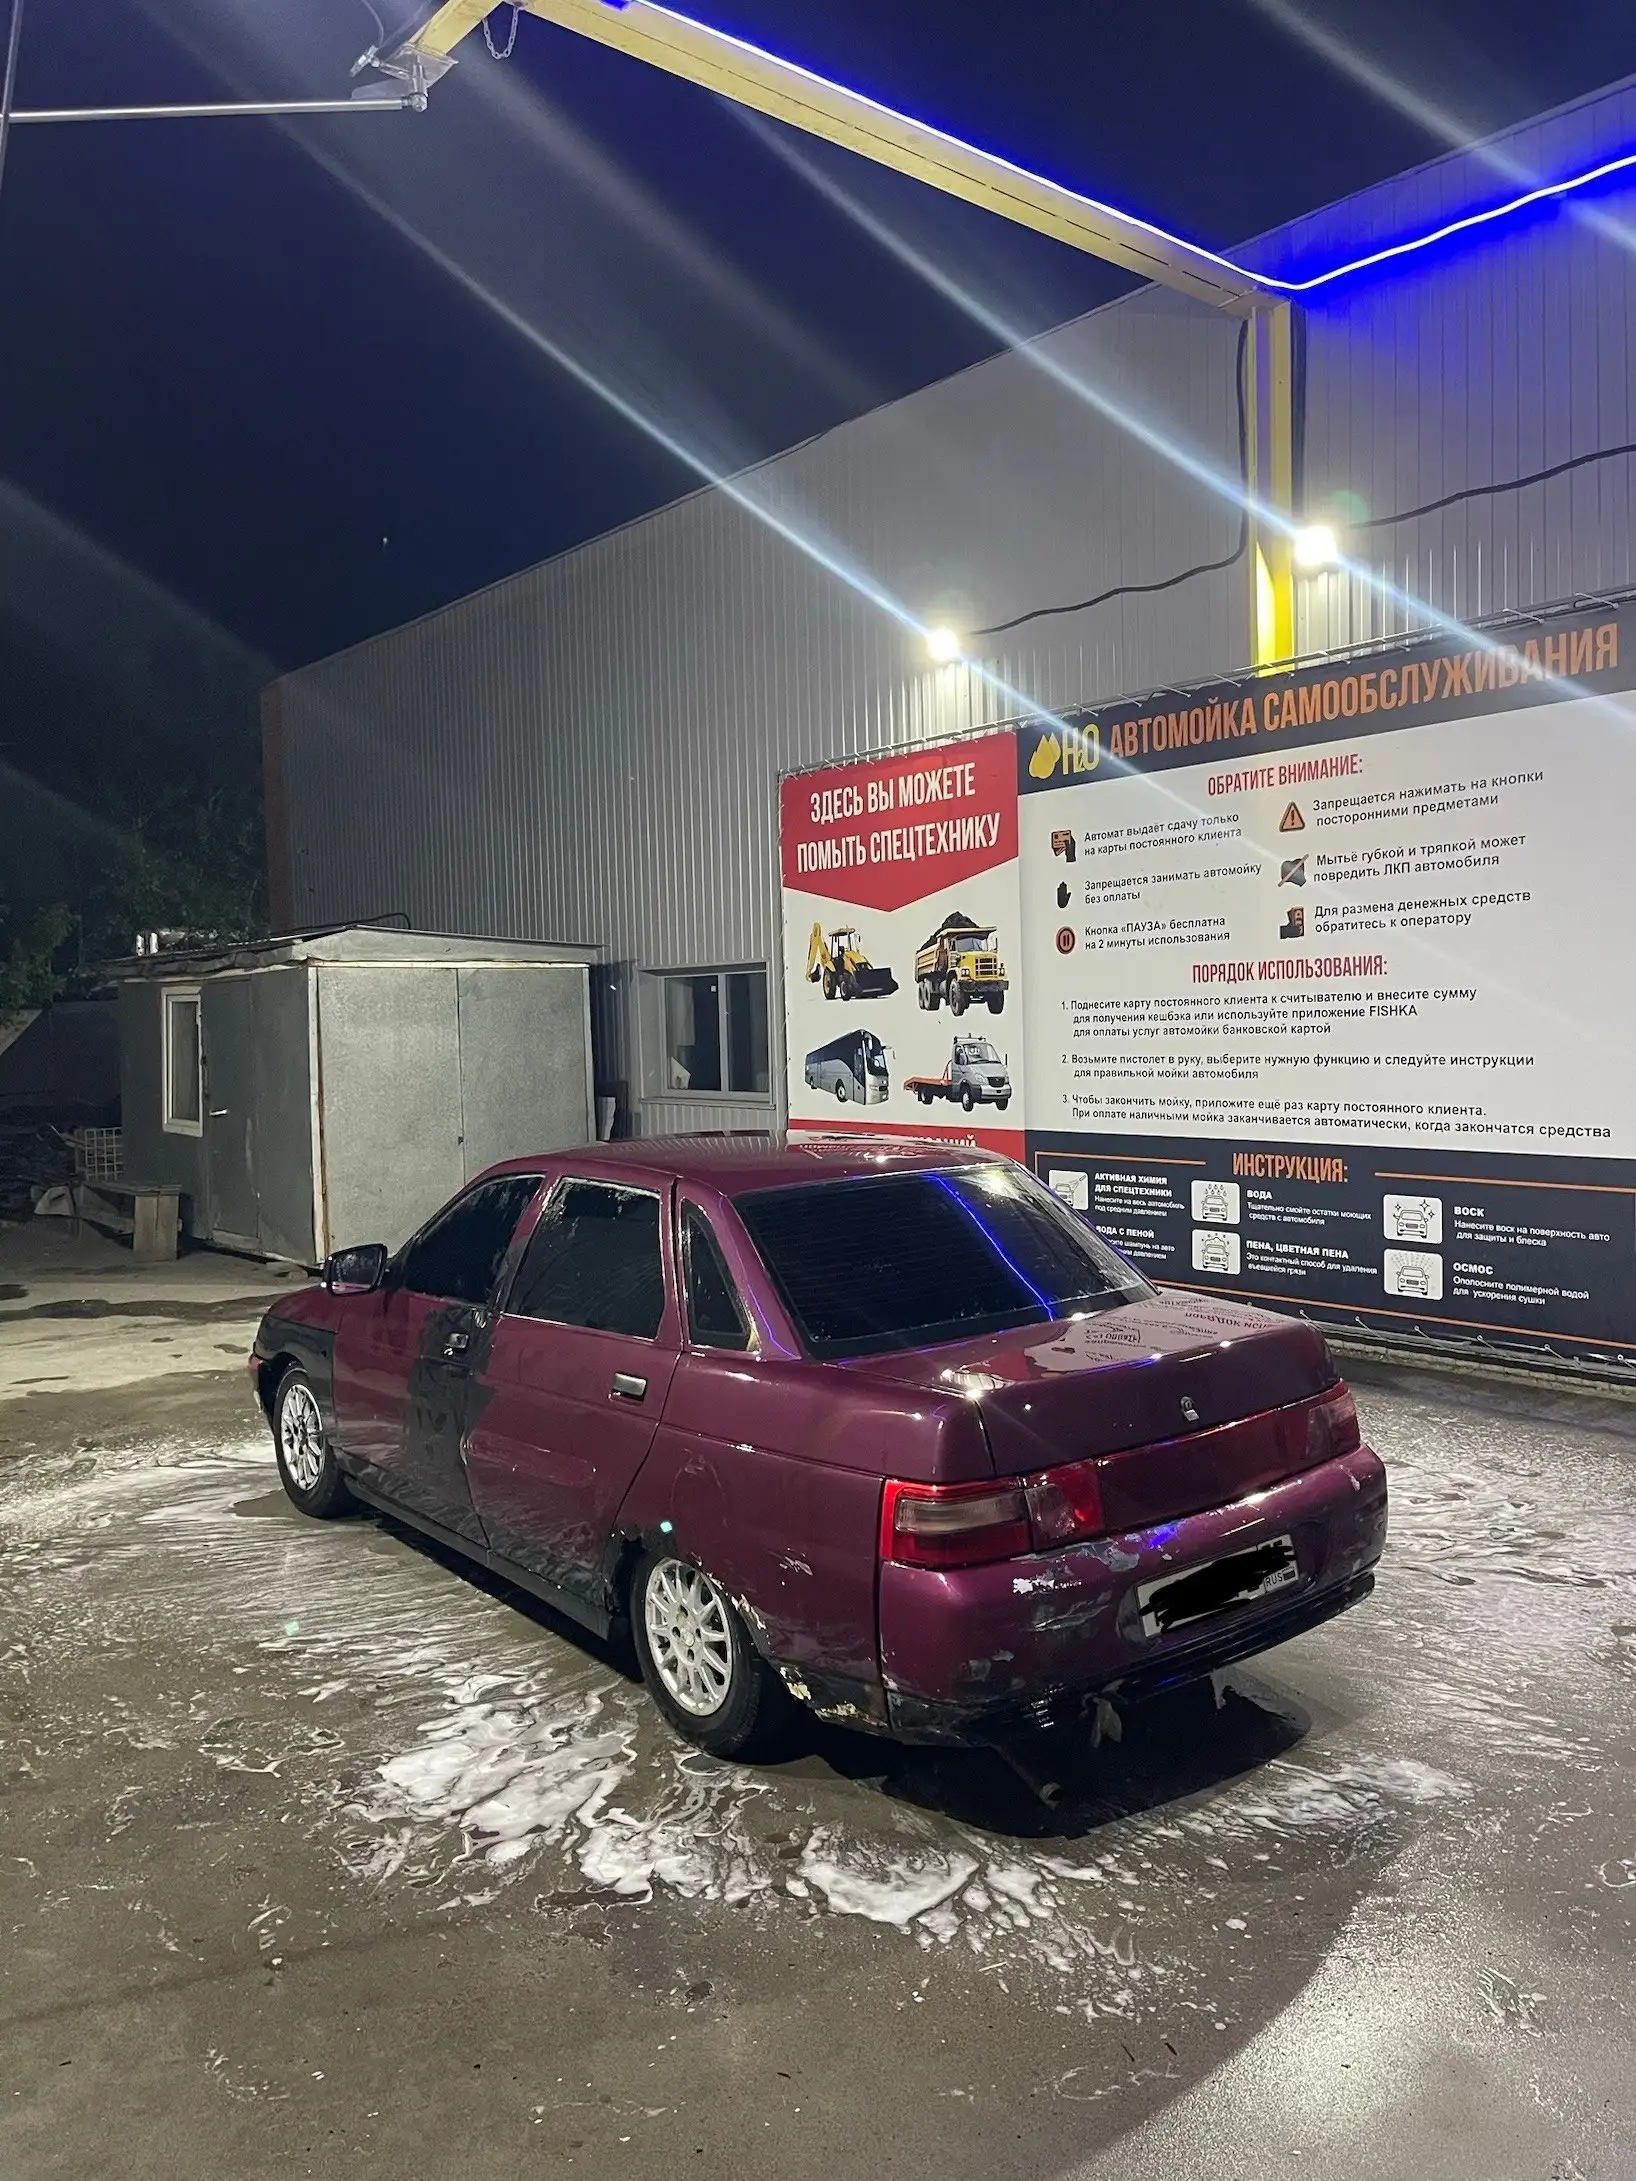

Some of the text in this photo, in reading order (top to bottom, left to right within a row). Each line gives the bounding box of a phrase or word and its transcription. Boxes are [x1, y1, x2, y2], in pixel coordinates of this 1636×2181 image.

[1110, 623, 1618, 759] АВТОМОЙКА САМООБСЛУЖИВАНИЯ
[1062, 724, 1100, 775] H2O
[1208, 754, 1363, 796] ОБРАТИТЕ ВНИМАНИЕ:
[811, 762, 976, 824] ЗДЕСЬ ВЫ МОЖЕТЕ
[1313, 771, 1543, 812] Запрещается нажимать на кнопки
[1317, 794, 1498, 826] посторонними предметами
[1085, 814, 1238, 842] Автомат выдаёт сдачу только
[797, 813, 1000, 873] ПОМЫТЬ СПЕЦТЕХНИКУ
[1085, 828, 1242, 856] на карты постоянного клиента
[1317, 835, 1526, 866] Мытьё губкой и тряпкой может
[1085, 863, 1262, 890] Запрещается занимать автомойку
[1314, 854, 1499, 882] повредить ЛКП автомобиля
[1085, 892, 1140, 904] без оплаты
[1315, 891, 1531, 919] Для размена денежных средств
[1085, 917, 1225, 936] Кнопка «ПАУЗА» бесплатна
[1315, 912, 1471, 933] обратитесь к оператору
[1086, 932, 1230, 950] на 2 минуты использования
[1193, 955, 1388, 984] ПОРЯДОК ИСПОЛЬЗОВАНИЯ:
[1062, 988, 1477, 1011] 1. Поднесите карту постоянного клиента к считывателю и внесите сумму
[1073, 1014, 1090, 1024] для
[1093, 1013, 1145, 1025] получения
[1195, 1010, 1214, 1021] или
[1218, 1008, 1288, 1022] используйте
[1292, 1007, 1365, 1020] приложение
[1369, 1005, 1417, 1017] FISHKA
[1073, 1022, 1331, 1038] для оплаты услуг автомойки банковской картой
[1062, 1053, 1534, 1067] 2. Возьмите пистолет в руку, выберите нужную функцию и следуйте инструкции
[1074, 1067, 1258, 1079] для правильной мойки автомобиля
[1072, 1095, 1102, 1105] Чтобы
[1105, 1096, 1155, 1106] закончить
[1159, 1097, 1192, 1108] мойку,
[1196, 1098, 1254, 1109] приложите
[1258, 1098, 1281, 1109] ещё
[1284, 1101, 1304, 1111] раз
[1307, 1101, 1339, 1113] карту
[1344, 1102, 1423, 1114] постоянного
[1428, 1105, 1486, 1116] клиента.
[1072, 1108, 1610, 1138] При оплате наличными мойка заканчивается автоматически, когда закончатся средства
[1233, 1153, 1348, 1183] ИНСТРУКЦИЯ:
[1095, 1173, 1167, 1185] АКТИВНАЯ ХИМИЯ
[1113, 1186, 1172, 1197] СПЕЦТЕХНИКИ
[1247, 1190, 1272, 1200] ВОДА
[1248, 1202, 1371, 1220] Тщательно смойте остатки моющих
[1283, 1215, 1325, 1225] автомобиля
[1454, 1206, 1484, 1217] ВОСК
[1127, 1229, 1154, 1238] ПЕНОЙ
[1454, 1220, 1494, 1232] Нанесите
[1530, 1228, 1586, 1239] поверхность
[1589, 1233, 1610, 1241] авто
[1474, 1233, 1506, 1243] защиты
[1516, 1236, 1547, 1246] блеска
[1246, 1240, 1348, 1259] ПЕНА, ЦВЕТНАЯ ПЕНА
[1246, 1253, 1259, 1261] Это
[1301, 1258, 1325, 1268] способ
[1327, 1262, 1340, 1270] для
[1453, 1262, 1494, 1275] ОСМОС
[1453, 1276, 1589, 1299] Ополосните полимерной водой
[1453, 1288, 1545, 1305] для ускорения сушки
[1265, 1573, 1283, 1586] RUS
